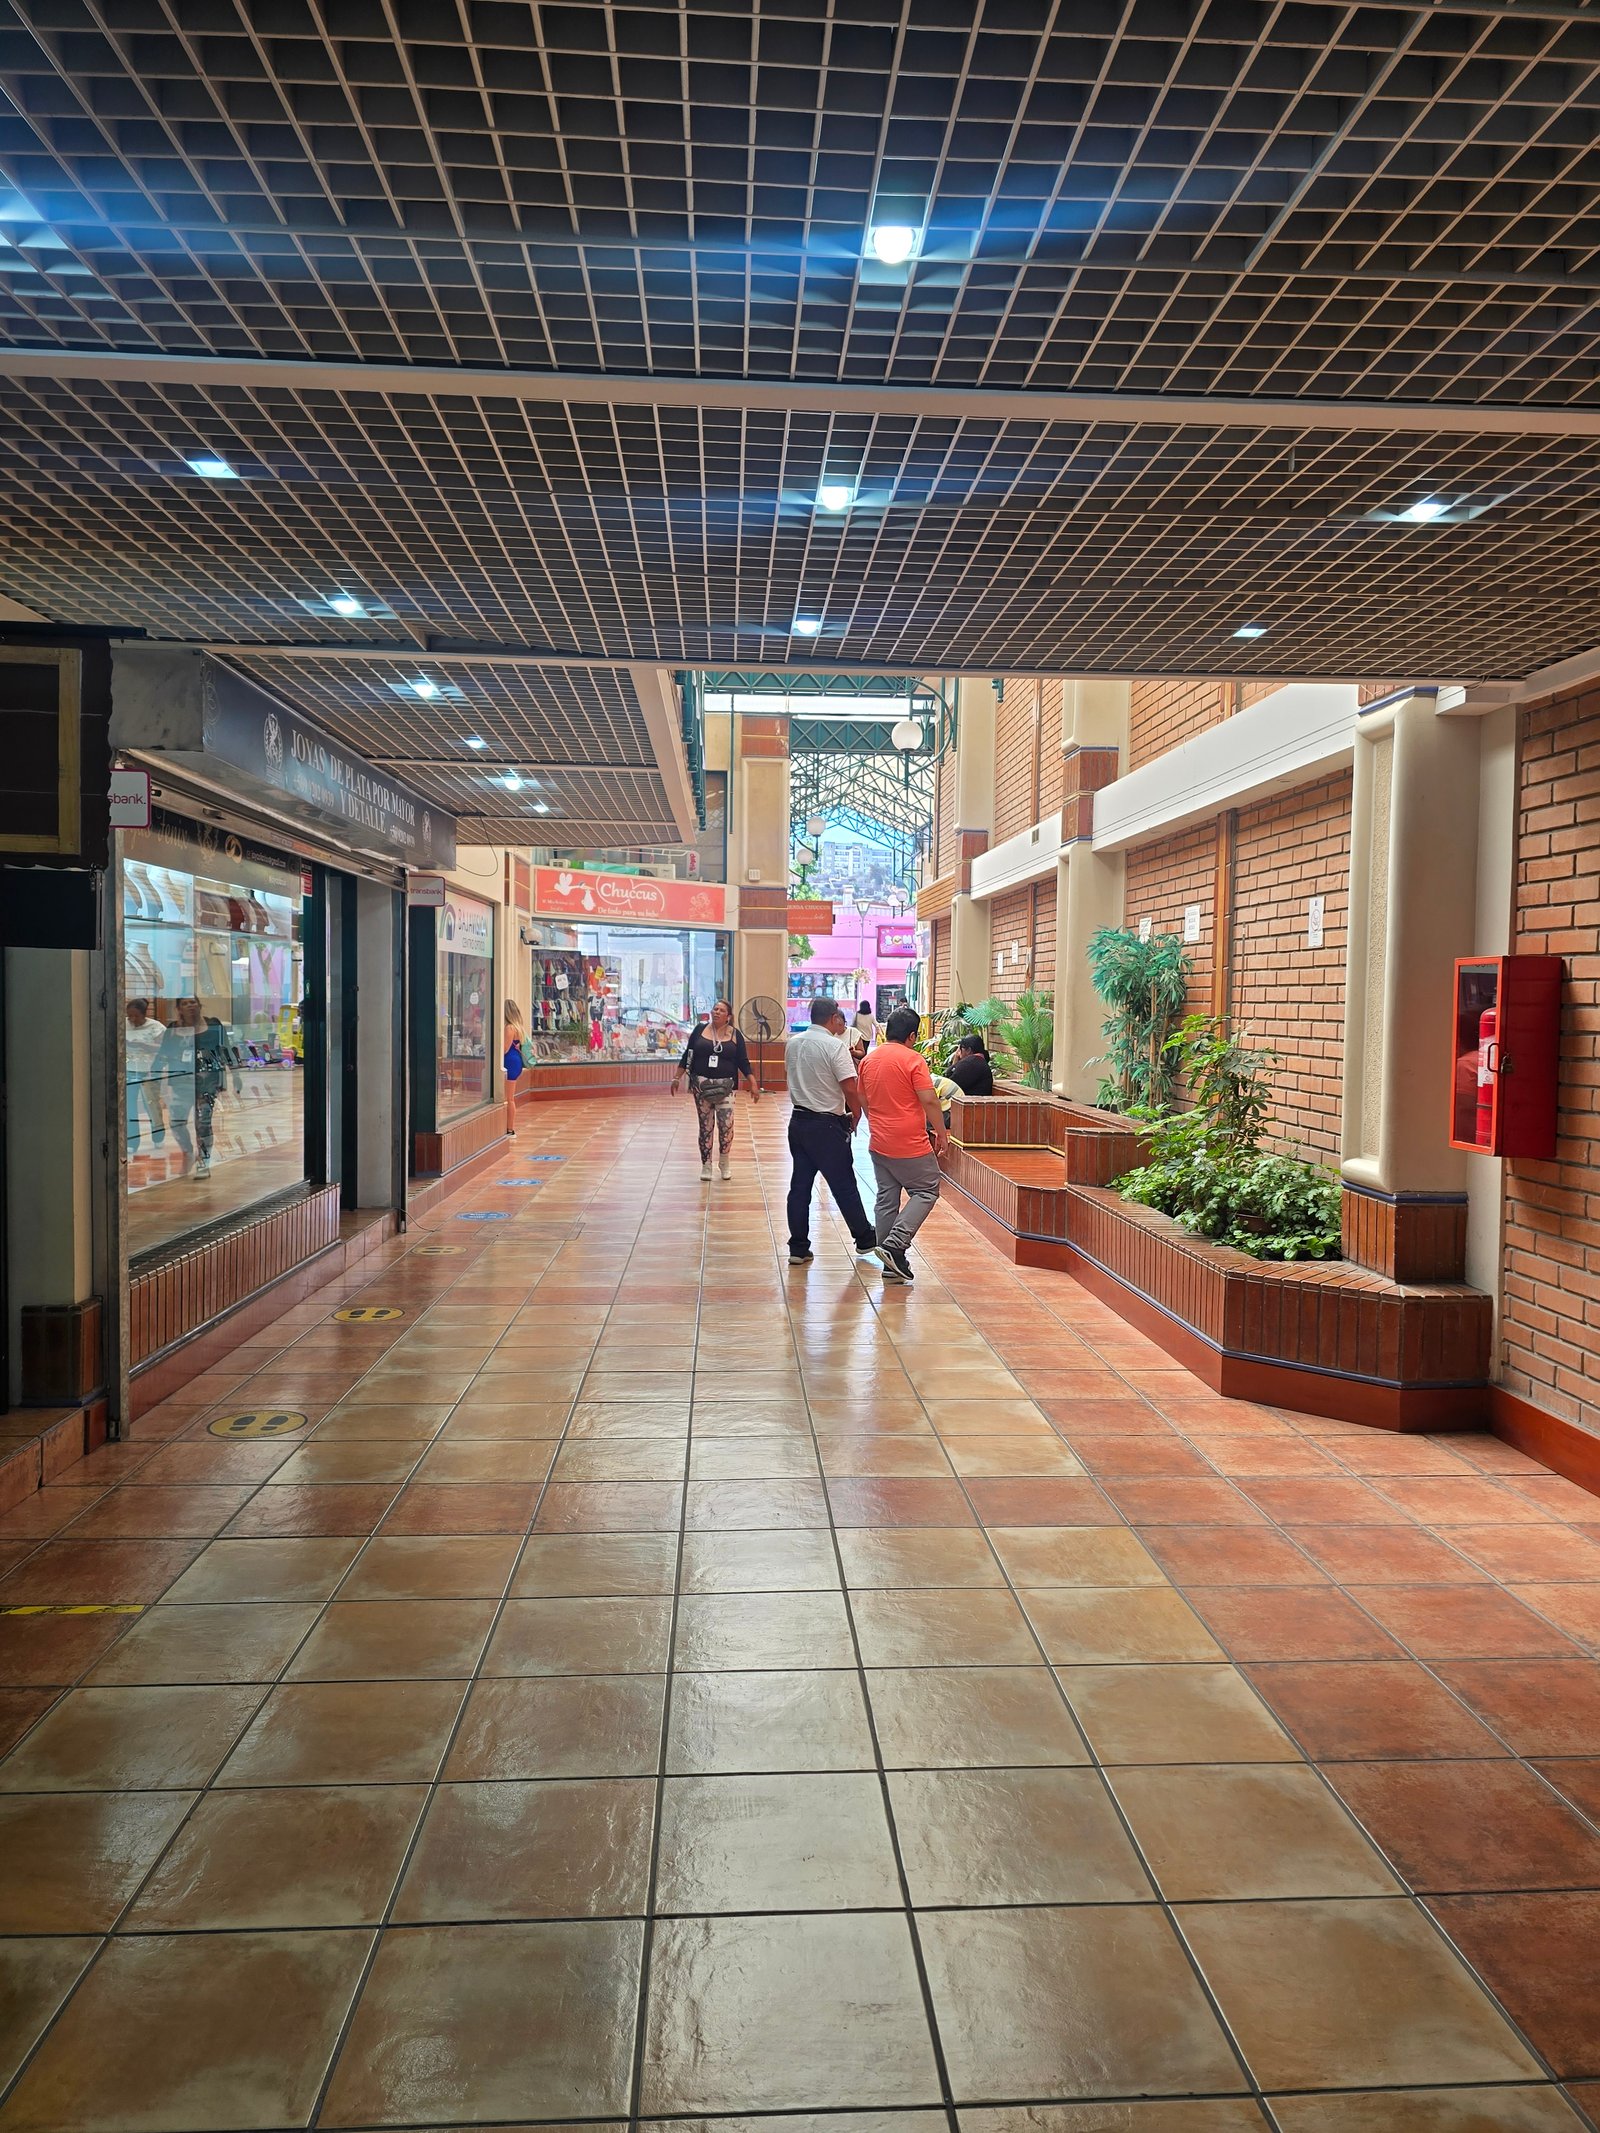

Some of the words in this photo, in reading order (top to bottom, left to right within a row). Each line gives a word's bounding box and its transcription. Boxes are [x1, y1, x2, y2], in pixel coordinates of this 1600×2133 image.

[290, 729, 325, 774] JOYAS
[330, 754, 344, 785] DE
[345, 764, 372, 802] PLATA
[372, 781, 390, 812] POR
[391, 792, 416, 827] MAYOR
[107, 792, 147, 805] sbank.
[339, 789, 347, 814] Y
[348, 793, 386, 834] DETALLE
[600, 882, 658, 901] Chuccus
